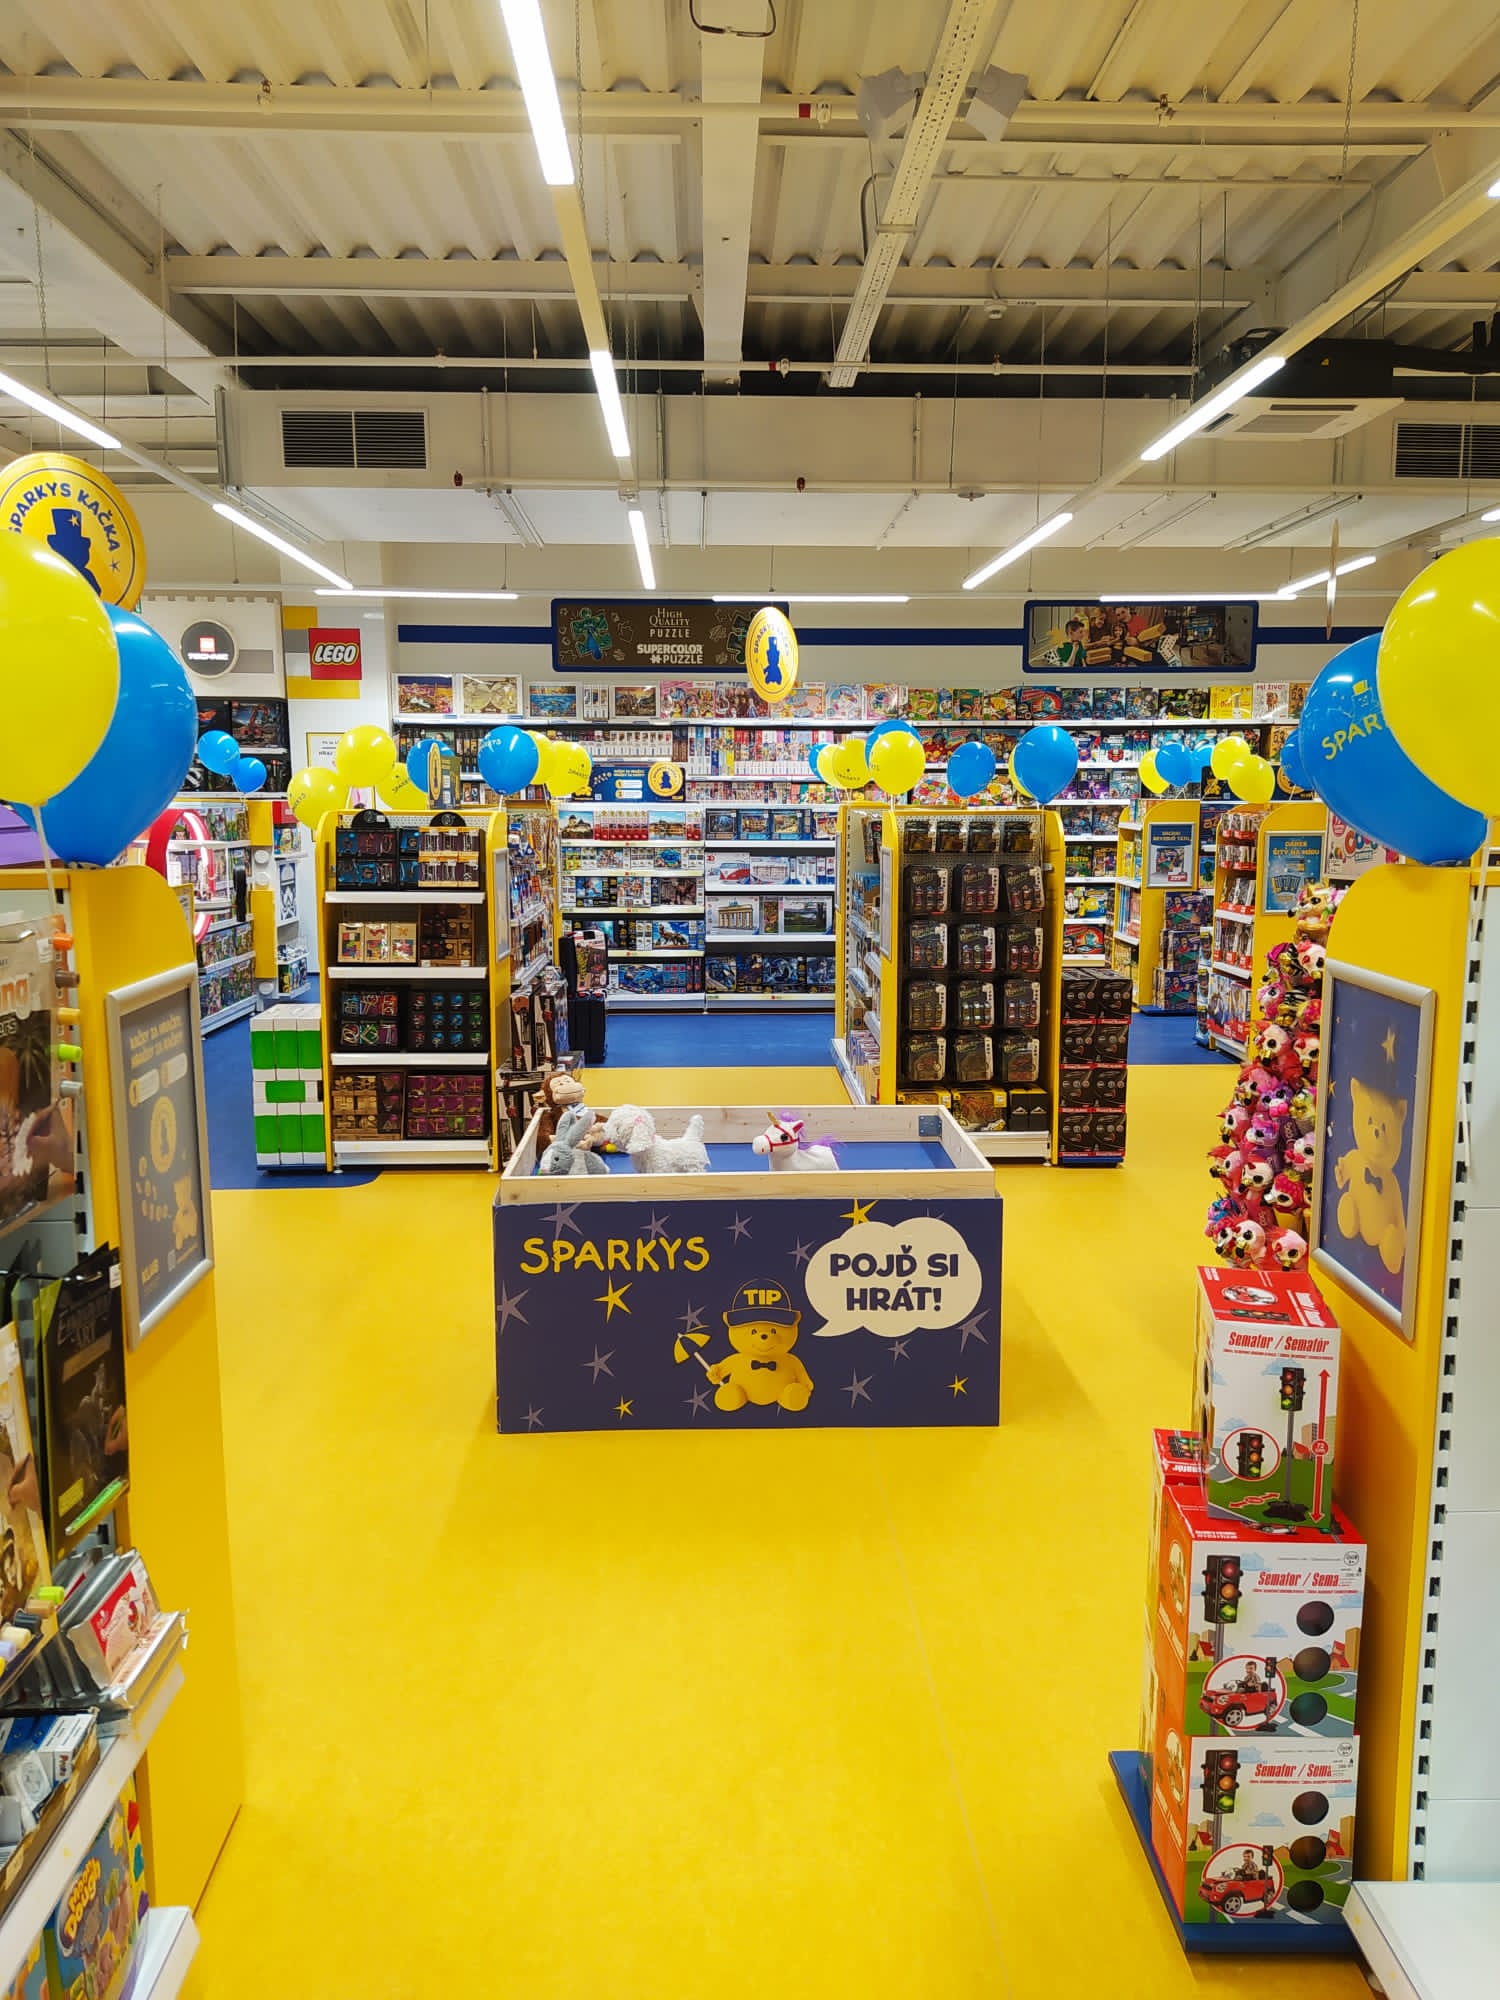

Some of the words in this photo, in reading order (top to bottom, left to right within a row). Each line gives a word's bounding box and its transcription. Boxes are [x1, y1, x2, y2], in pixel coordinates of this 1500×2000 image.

[77, 489, 120, 552] KAČKA
[649, 615, 690, 627] QUALITY
[657, 607, 683, 619] HIGH
[650, 628, 691, 638] PUZZLE
[313, 644, 358, 664] LEGO
[636, 643, 704, 655] SUPERCOLOR
[662, 654, 703, 665] PUZZLE
[1321, 713, 1383, 761] SPAR
[520, 1236, 710, 1274] SPARKYS
[830, 1245, 918, 1278] POJĎ
[928, 1252, 959, 1277] SI
[743, 1289, 782, 1306] TIP
[846, 1280, 943, 1312] HRÁT!
[1228, 1331, 1274, 1350] Semafor
[1284, 1336, 1330, 1353] Semafór
[1258, 1571, 1302, 1587] Semafor
[1311, 1571, 1339, 1587] Sema
[1254, 1762, 1297, 1778] Semafor
[1306, 1763, 1332, 1778] Sema
